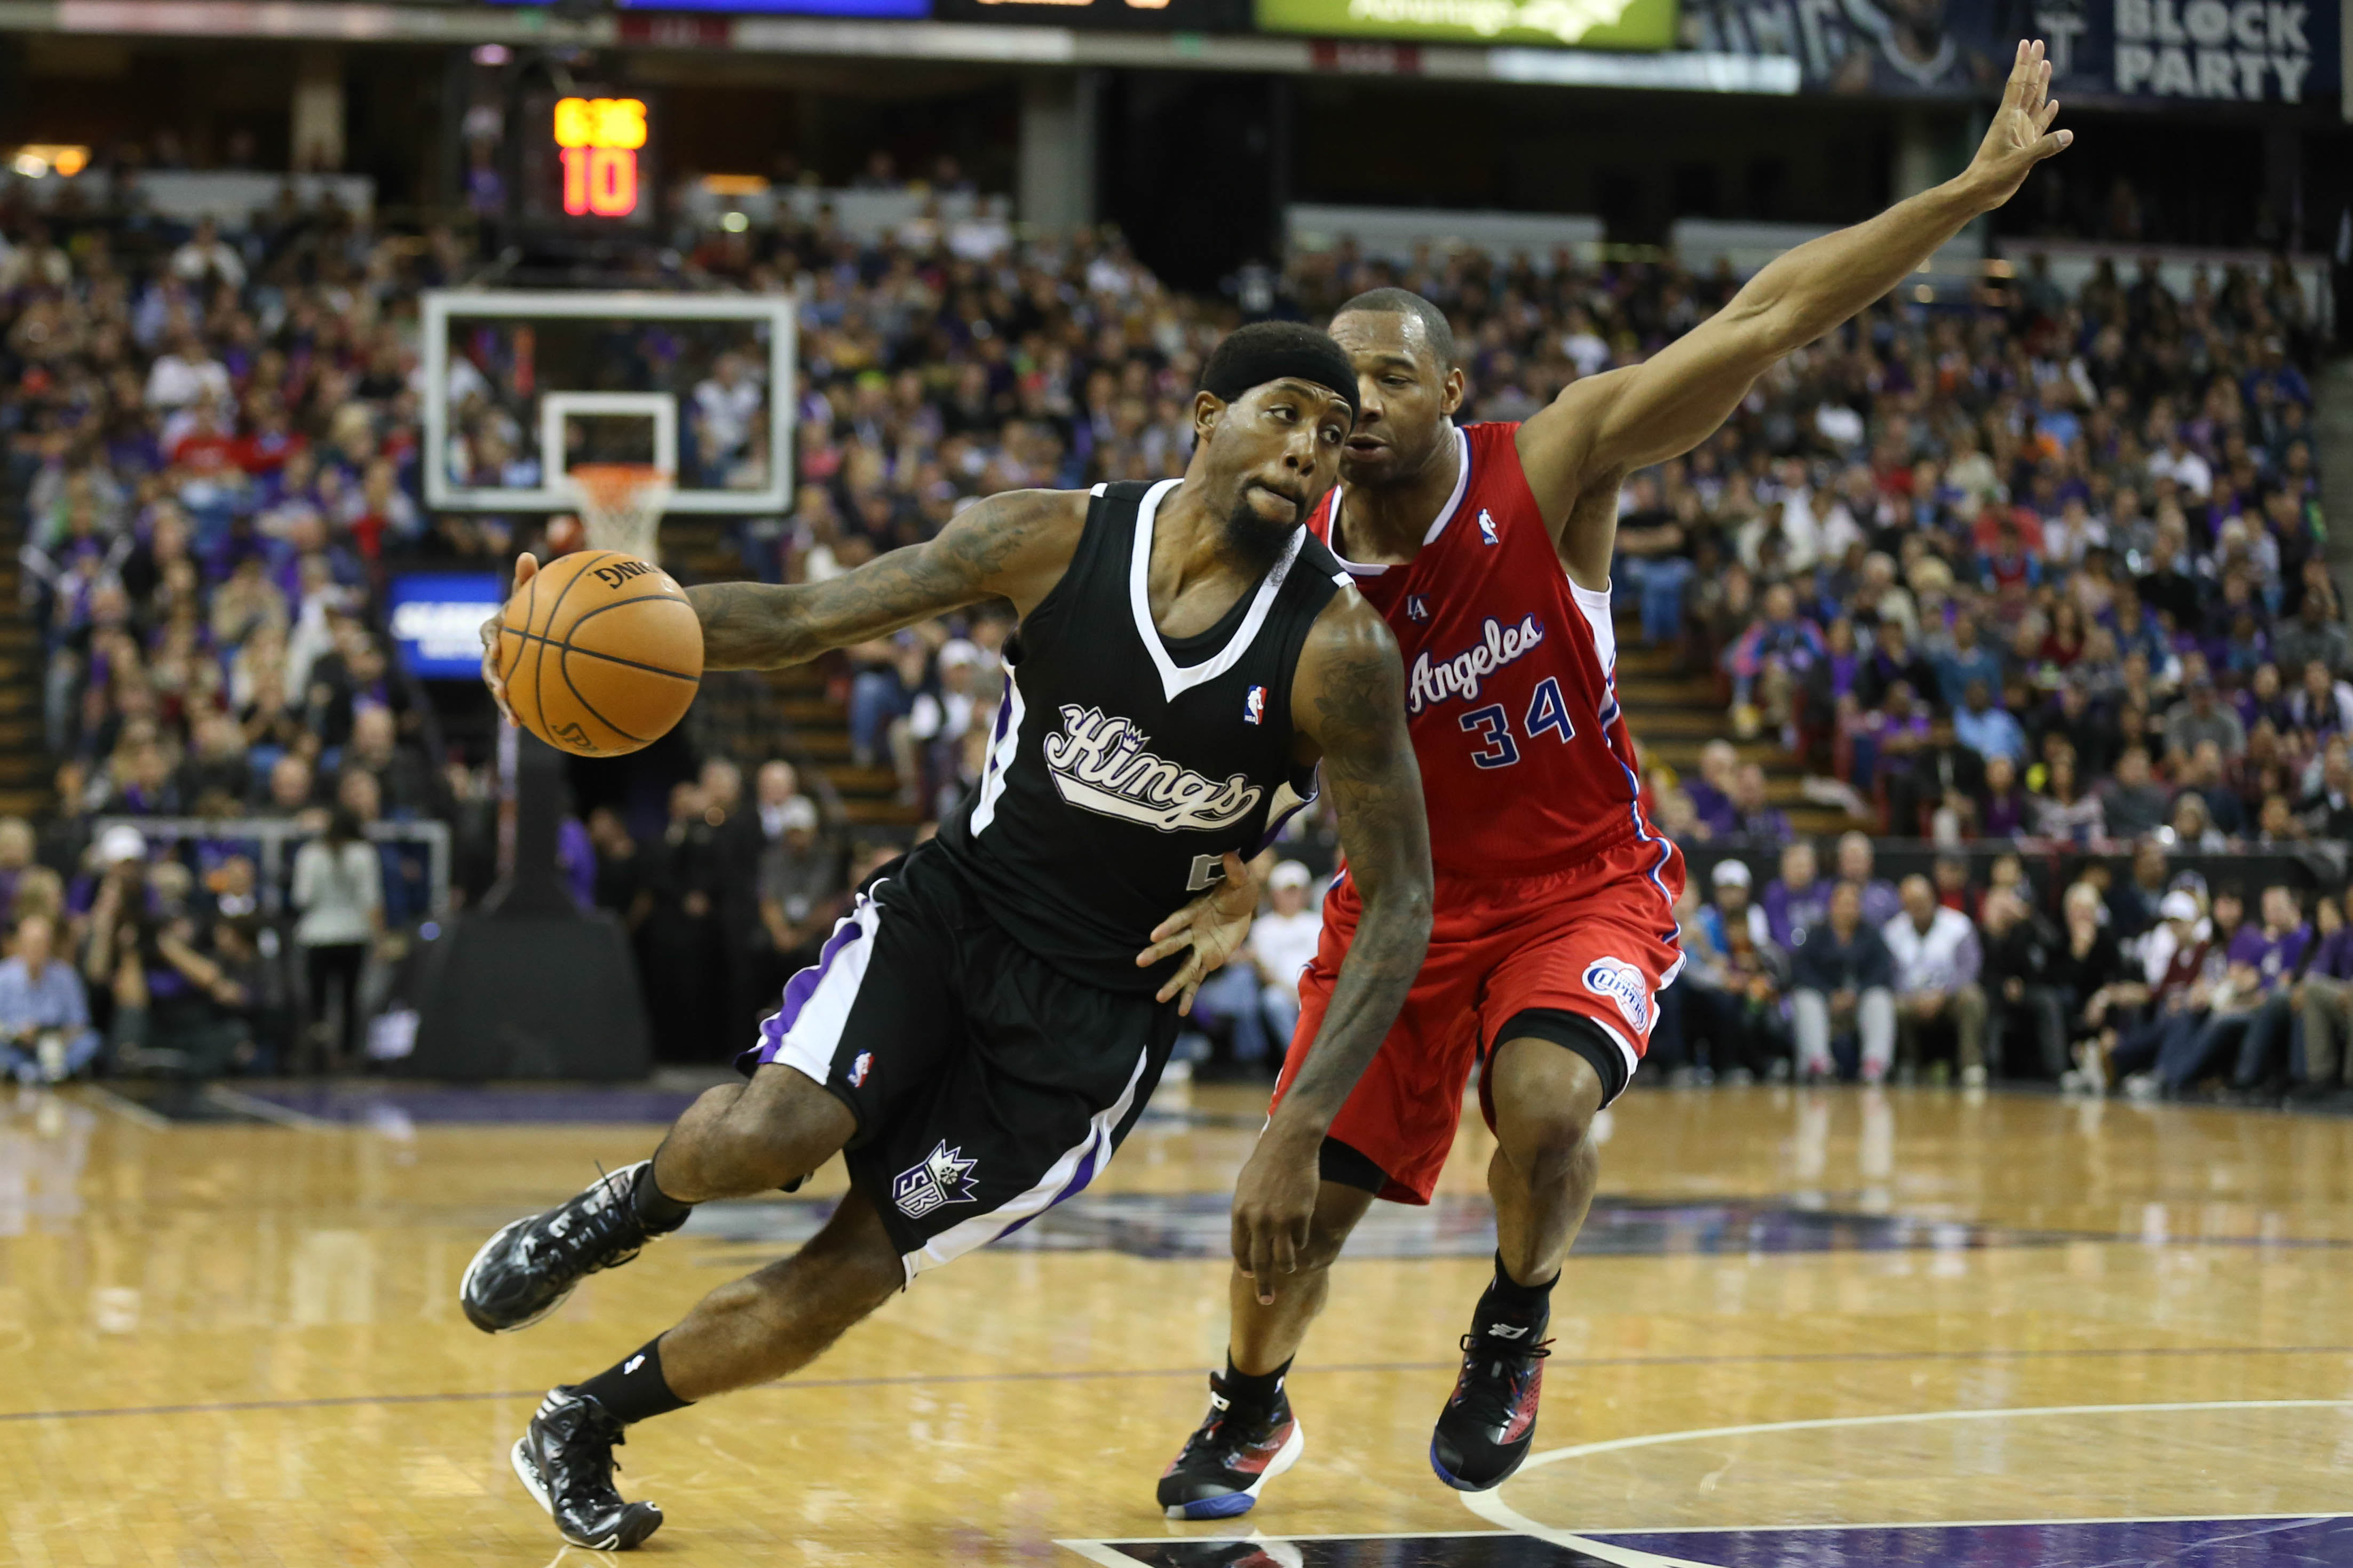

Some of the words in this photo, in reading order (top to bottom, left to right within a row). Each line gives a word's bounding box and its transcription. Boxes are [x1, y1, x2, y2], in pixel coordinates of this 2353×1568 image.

[2113, 0, 2310, 52] BLOCK
[2114, 45, 2310, 105] PARTY
[560, 146, 637, 216] 10
[1407, 612, 1544, 714] Angeles
[1459, 675, 1576, 769] 34
[1043, 703, 1264, 833] Kings
